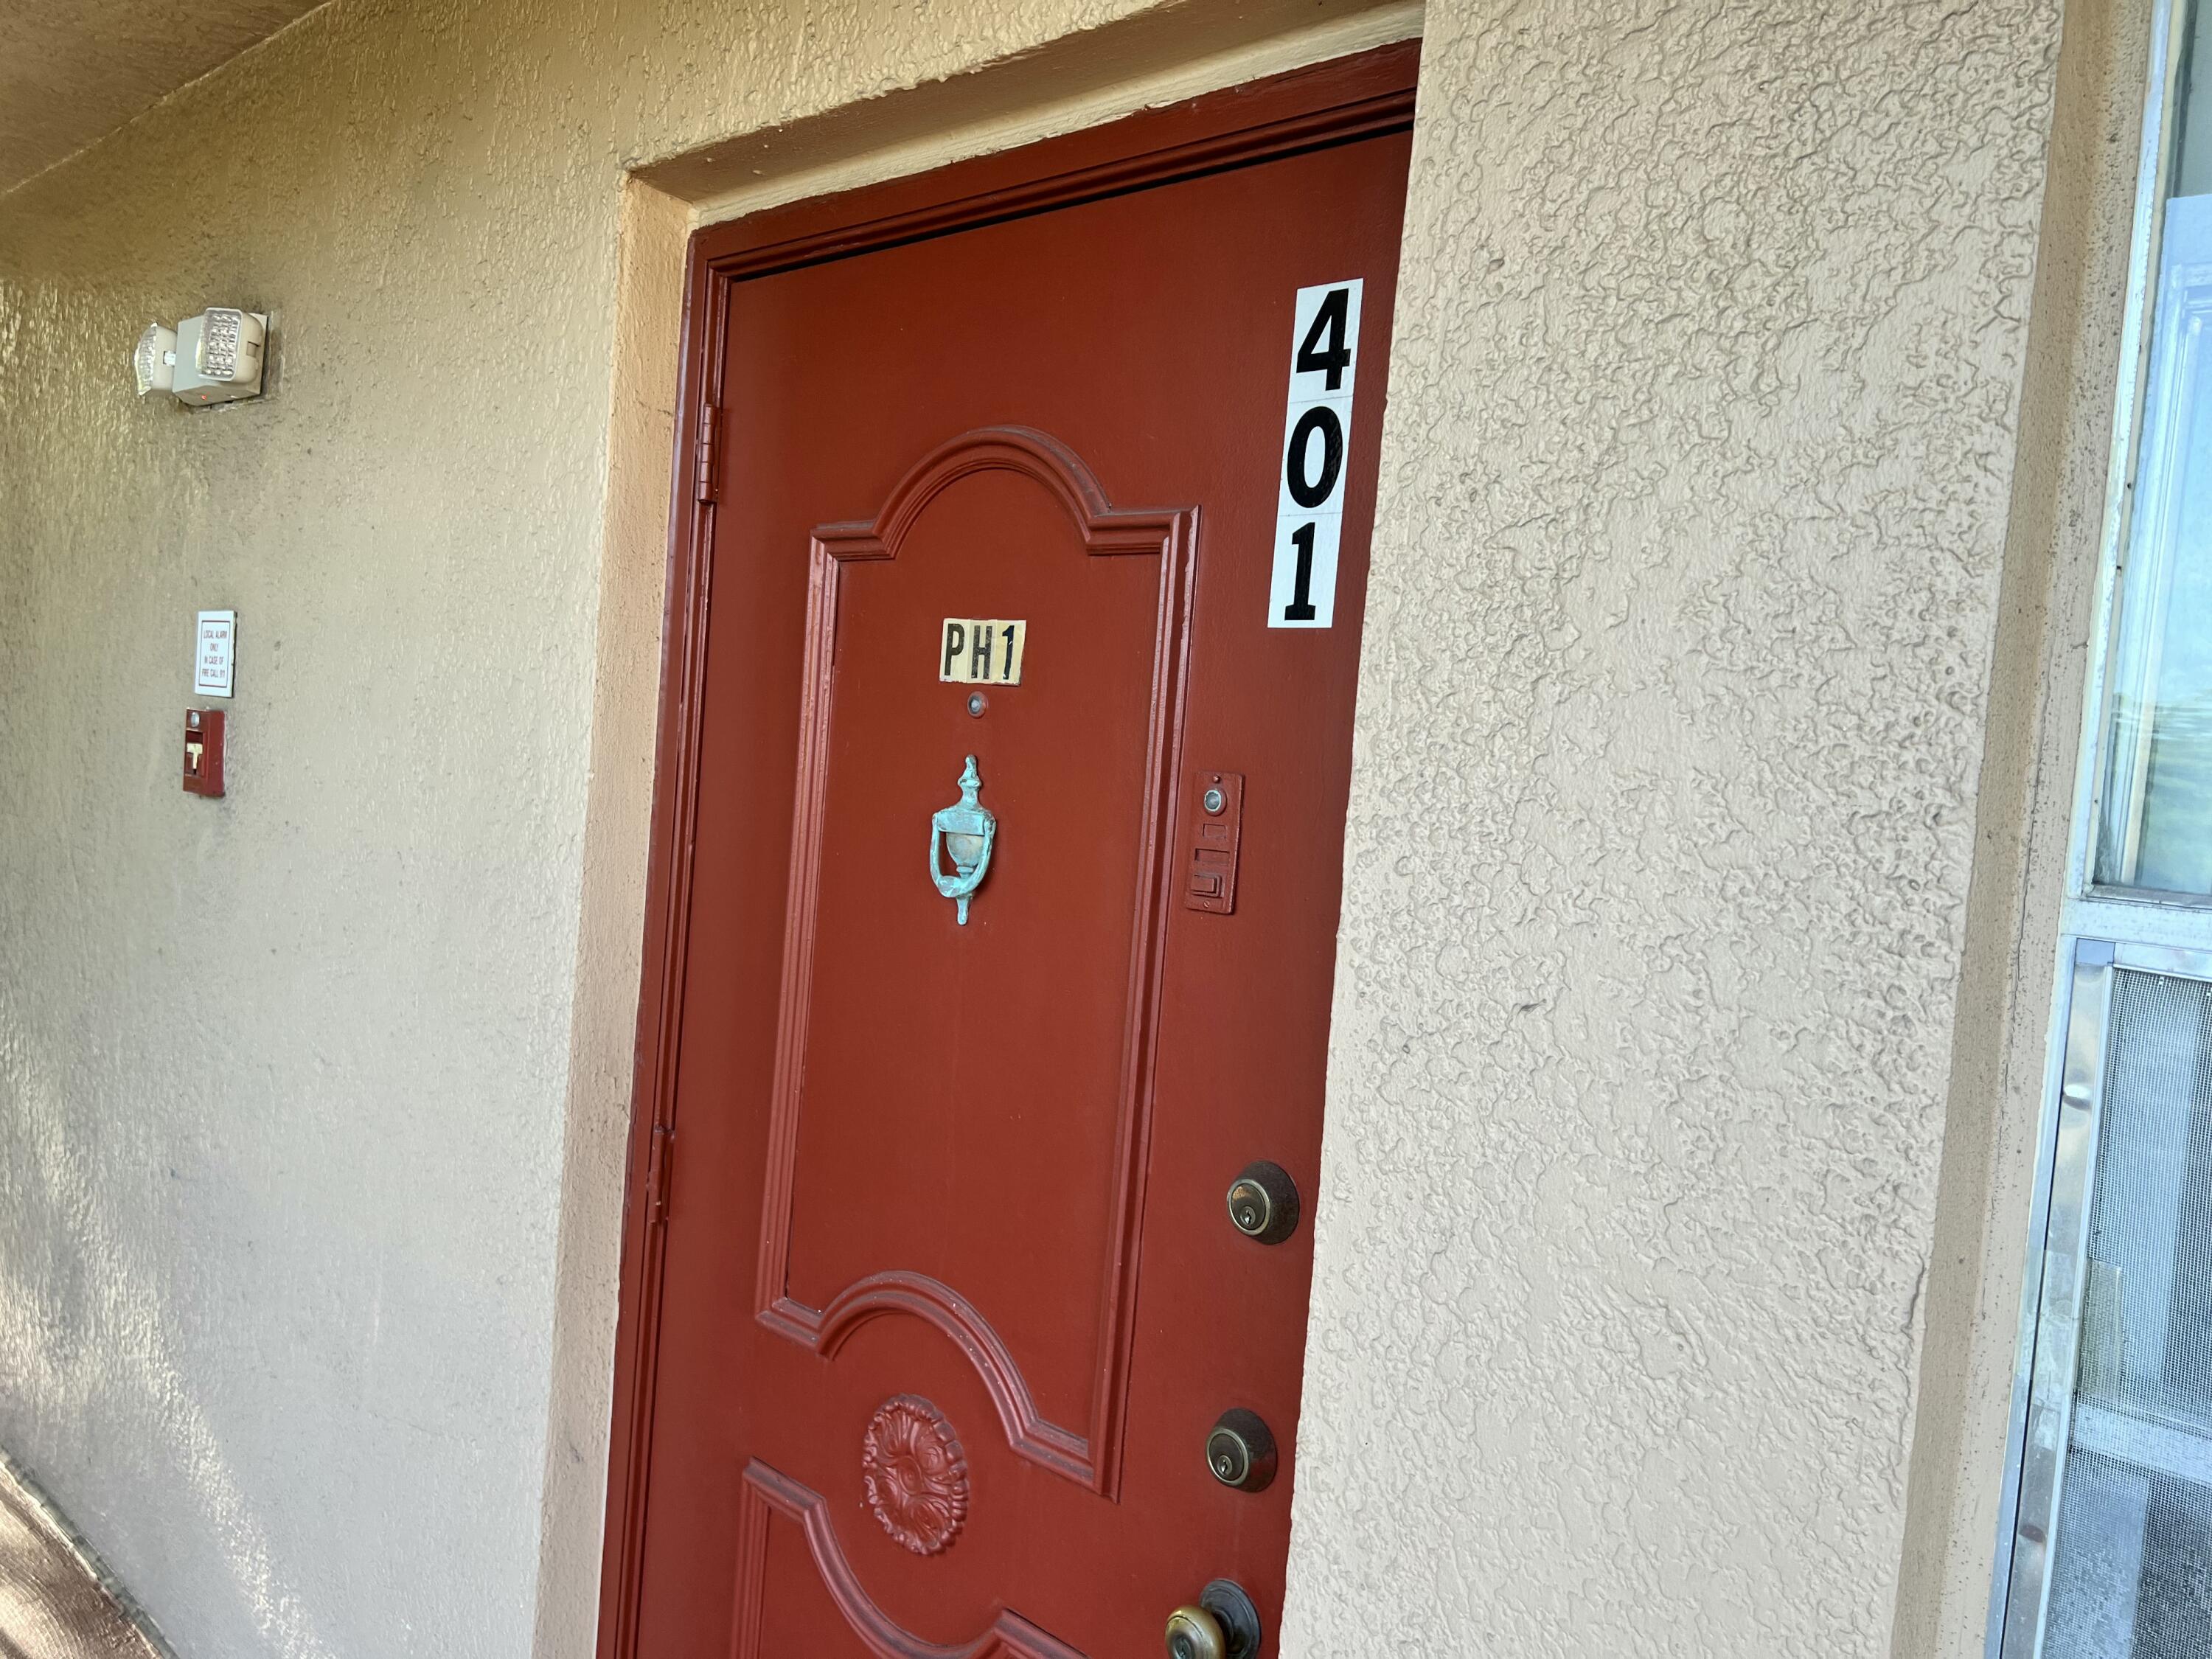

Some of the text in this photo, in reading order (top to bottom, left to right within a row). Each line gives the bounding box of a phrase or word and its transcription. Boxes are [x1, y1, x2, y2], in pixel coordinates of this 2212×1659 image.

[1284, 288, 1352, 621] 401
[204, 630, 228, 639] LOCAL ALARM
[209, 643, 218, 652] ONLY
[944, 623, 1015, 680] PH1
[204, 655, 224, 665] IN CASE OF
[210, 669, 218, 678] CALL
